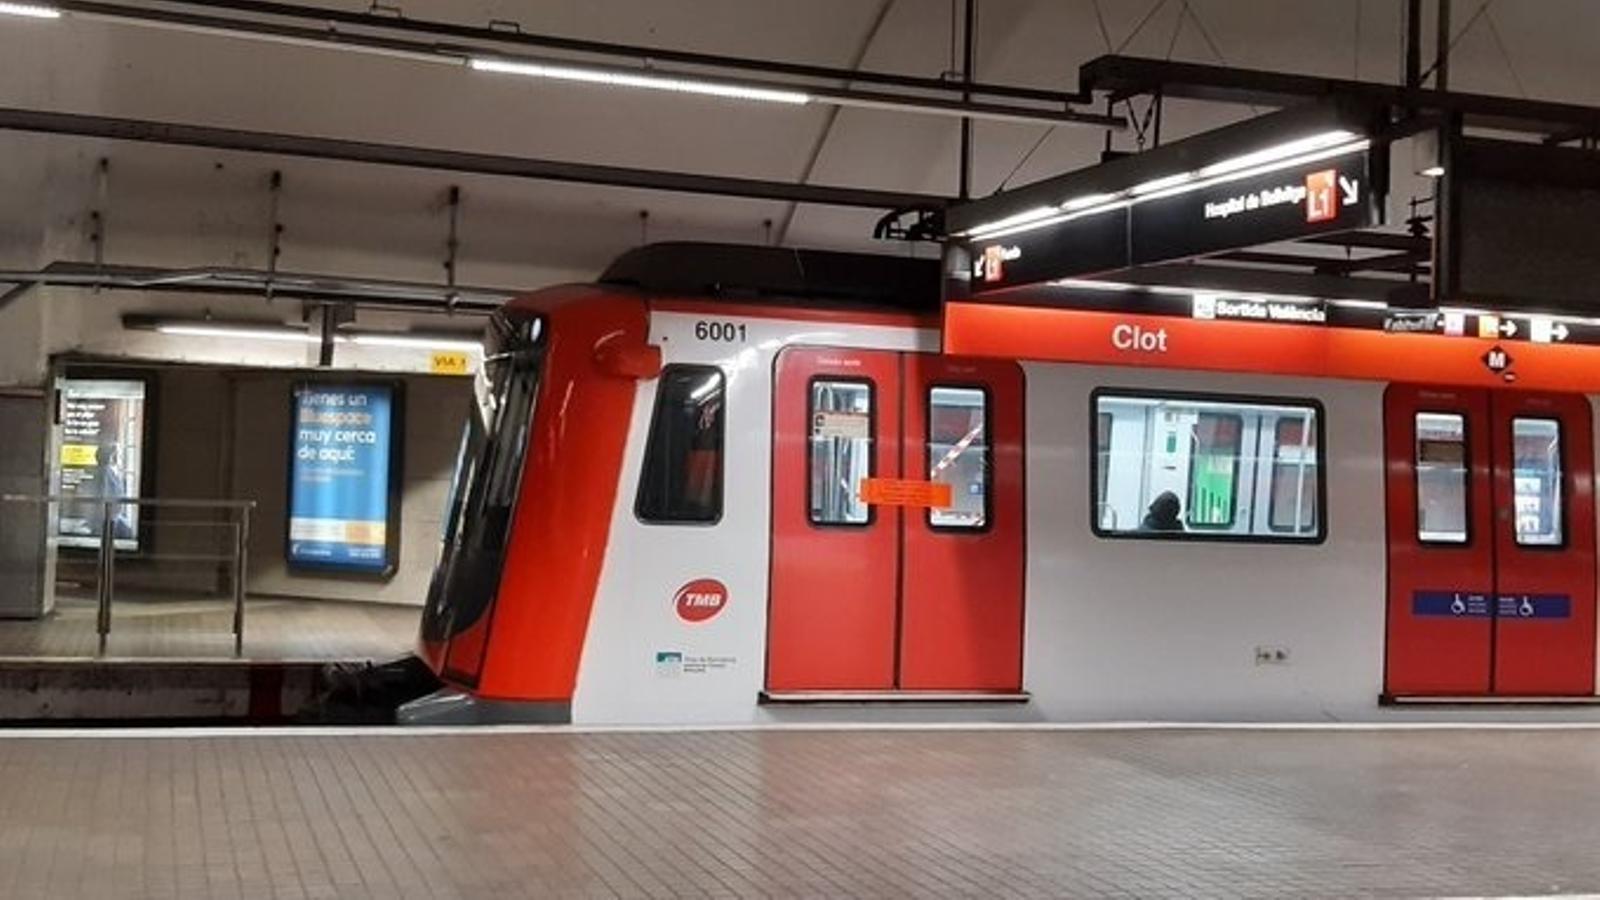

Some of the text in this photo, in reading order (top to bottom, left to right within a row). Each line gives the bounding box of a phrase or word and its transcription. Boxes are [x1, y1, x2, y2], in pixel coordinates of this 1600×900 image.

[1307, 188, 1330, 220] L1
[1217, 301, 1267, 318] Sortida
[695, 320, 746, 342] 6001
[1112, 324, 1167, 351] Clot
[433, 355, 457, 368] VIA
[1488, 351, 1506, 369] M
[349, 394, 368, 406] un
[300, 430, 376, 446] muy cerca
[298, 444, 317, 460] de
[686, 592, 721, 607] TMB
